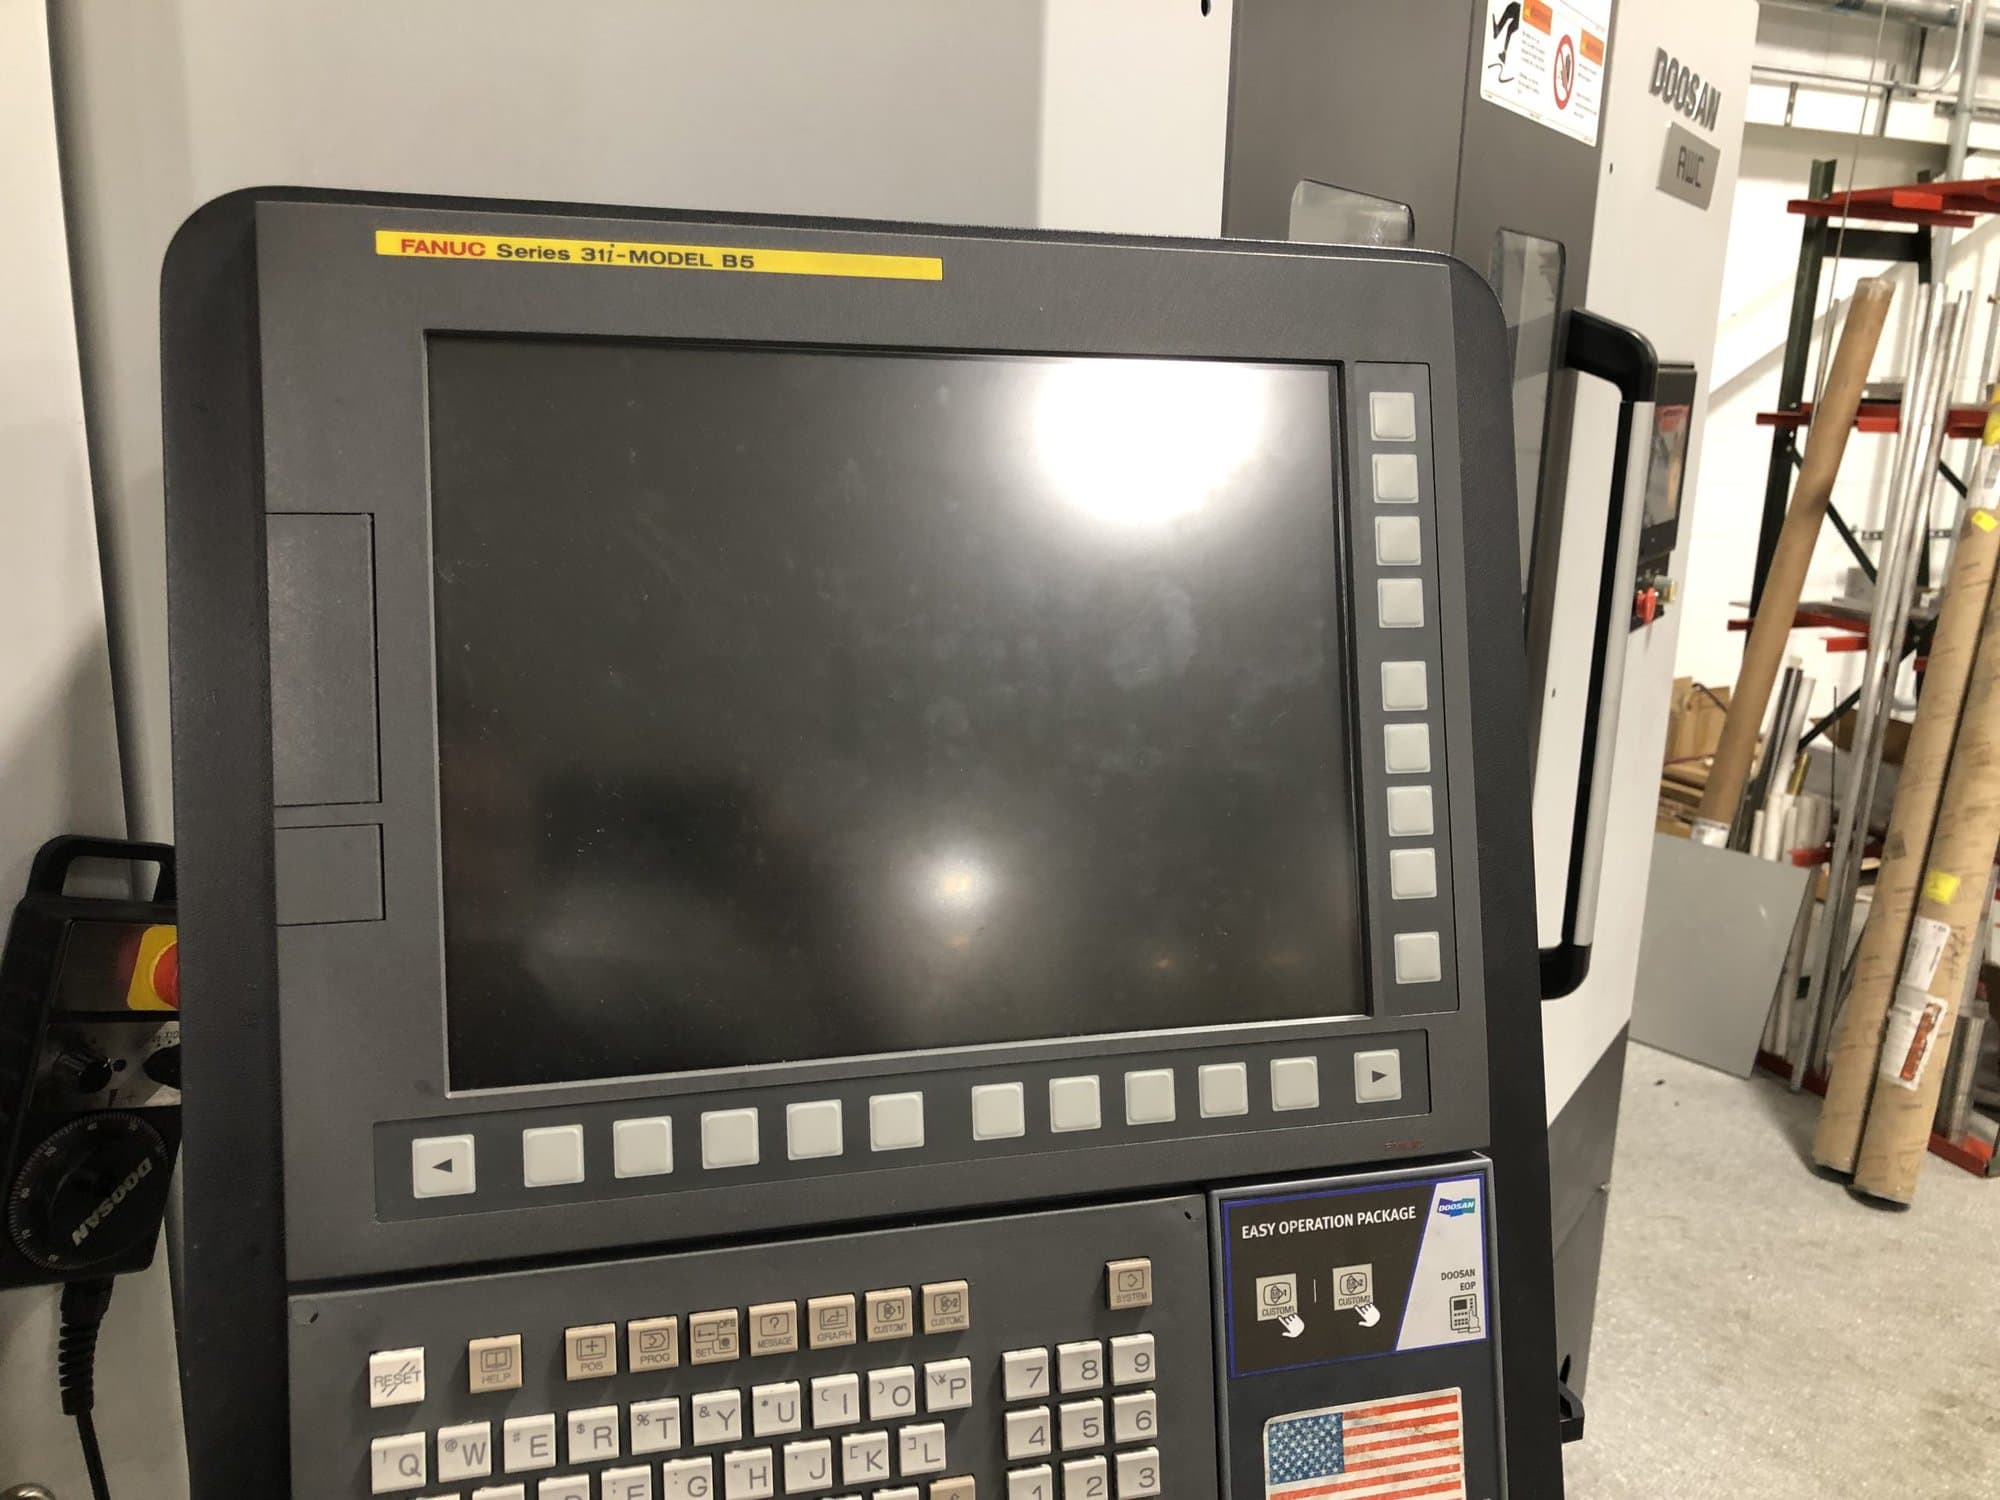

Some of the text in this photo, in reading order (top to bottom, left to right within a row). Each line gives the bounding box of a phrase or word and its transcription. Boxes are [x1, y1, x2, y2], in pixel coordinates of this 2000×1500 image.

[1649, 47, 1721, 131] DOOSAN
[401, 239, 486, 256] FANUC
[497, 243, 570, 261] Series
[722, 254, 754, 269] B5
[72, 1157, 152, 1246] DOOSAN
[1439, 1200, 1475, 1213] DOOSAN
[1241, 1205, 1416, 1240] EASY OPERATION PACKAGE
[1441, 1268, 1476, 1281] DOOSAN
[1460, 1281, 1476, 1291] EOP
[1116, 1291, 1147, 1304] SYSTEM
[1338, 1295, 1371, 1307] CUSTOM2
[1262, 1305, 1295, 1317] CUSTOM1
[757, 1336, 793, 1349] MESSAGE
[817, 1331, 852, 1342] GRAPH
[640, 1353, 670, 1364] PROG
[695, 1347, 712, 1358] SET
[1134, 1353, 1150, 1373] 9
[580, 1361, 603, 1372] POS
[1026, 1366, 1044, 1388] 7
[1082, 1360, 1098, 1380] 8
[374, 1369, 421, 1388] RESET
[481, 1372, 511, 1385] HELP
[950, 1378, 966, 1400] P
[844, 1394, 848, 1414] I
[892, 1386, 911, 1407] O
[700, 1406, 736, 1431] & Y
[778, 1401, 795, 1423] U
[1136, 1410, 1152, 1431] 6
[576, 1424, 613, 1449] $ R
[636, 1414, 674, 1440] % T
[1028, 1426, 1046, 1446] 4
[1083, 1417, 1099, 1438] 5
[462, 1442, 486, 1466] W
[530, 1434, 548, 1458] E
[924, 1443, 940, 1463] L
[399, 1453, 422, 1478] Q
[810, 1457, 826, 1480] J
[866, 1449, 883, 1472] K
[687, 1476, 708, 1498] G
[749, 1466, 767, 1489] H
[1086, 1476, 1103, 1497] 2
[1139, 1468, 1155, 1488] 3
[1032, 1485, 1042, 1500] 1
